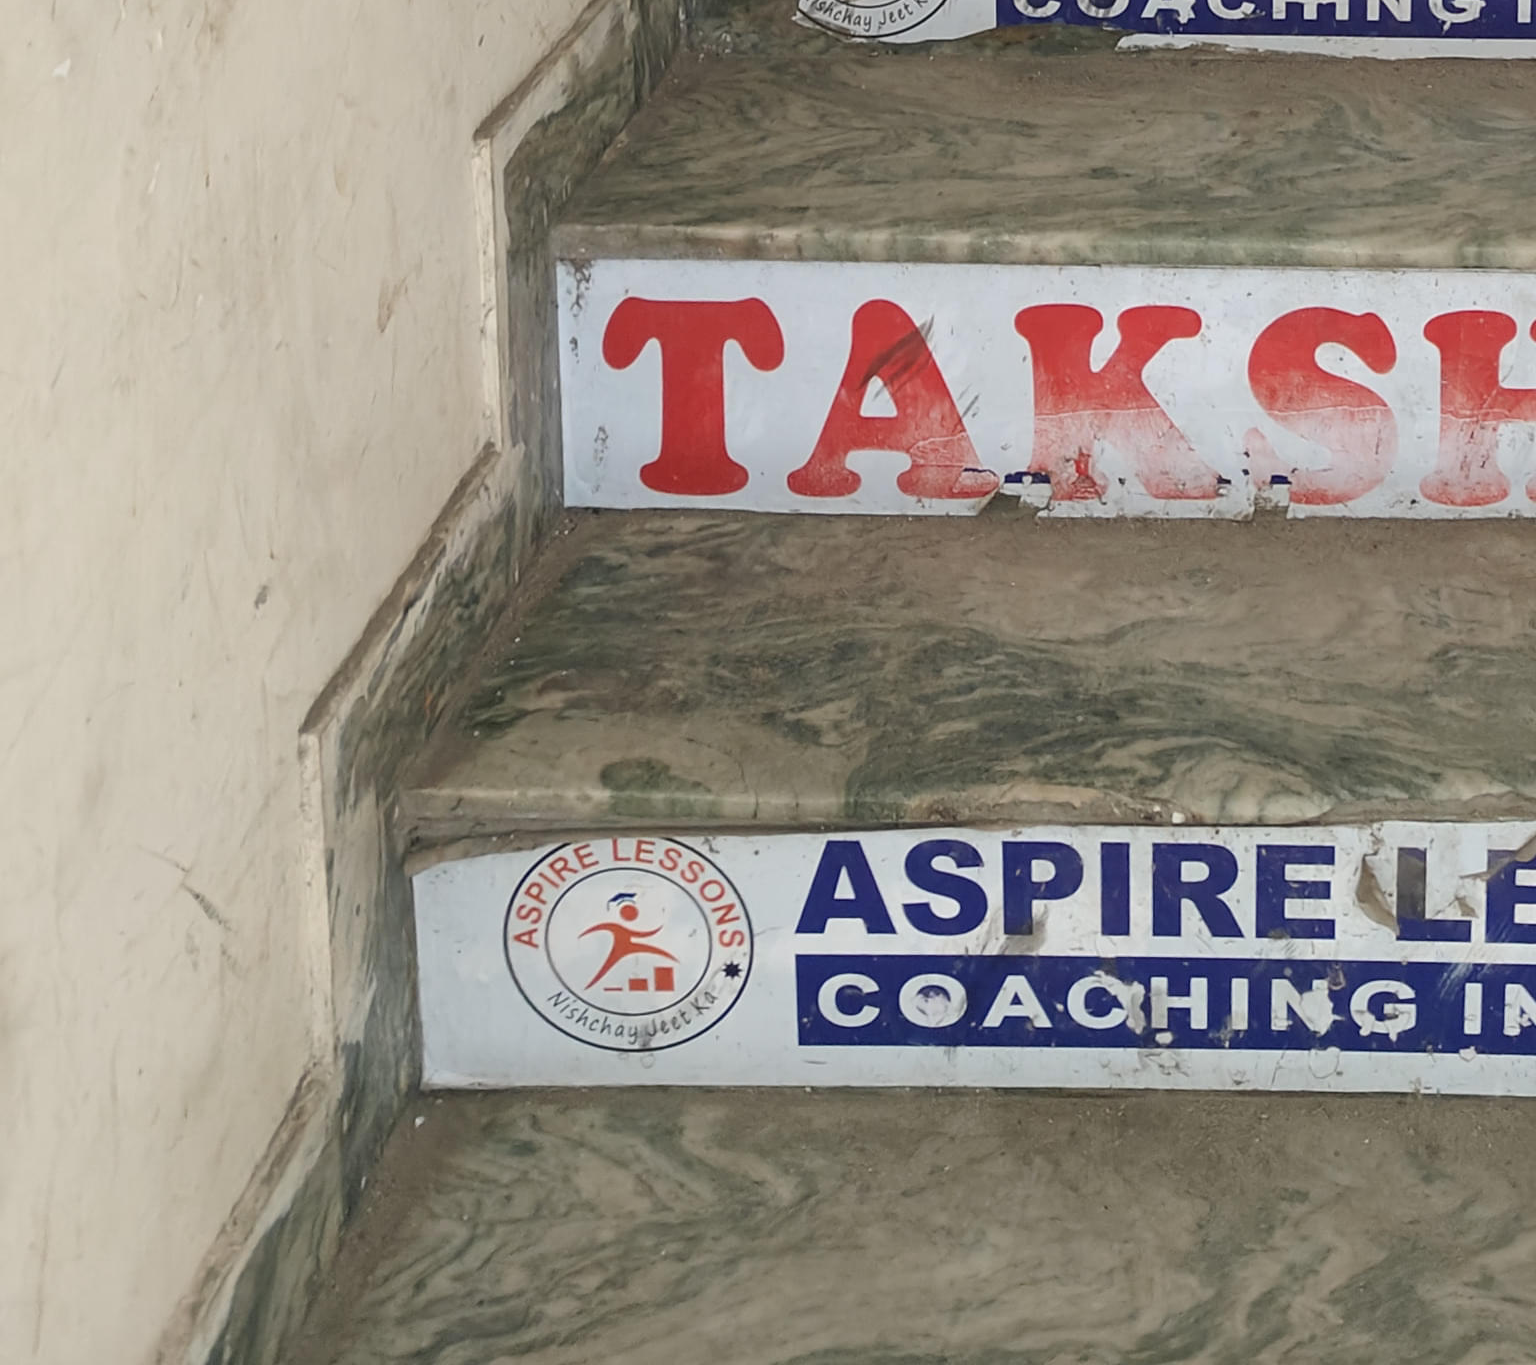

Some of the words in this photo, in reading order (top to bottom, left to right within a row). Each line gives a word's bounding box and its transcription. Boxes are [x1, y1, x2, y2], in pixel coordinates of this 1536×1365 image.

[878, 2, 911, 26] Jeet
[512, 843, 600, 949] ASPIRE
[610, 837, 746, 949] LESSONS
[797, 839, 1337, 942] ASPIRE
[547, 991, 639, 1045] Nishchay
[646, 1010, 692, 1038] Jeet
[690, 989, 719, 1019] Ka
[816, 972, 1417, 1036] COACHING
